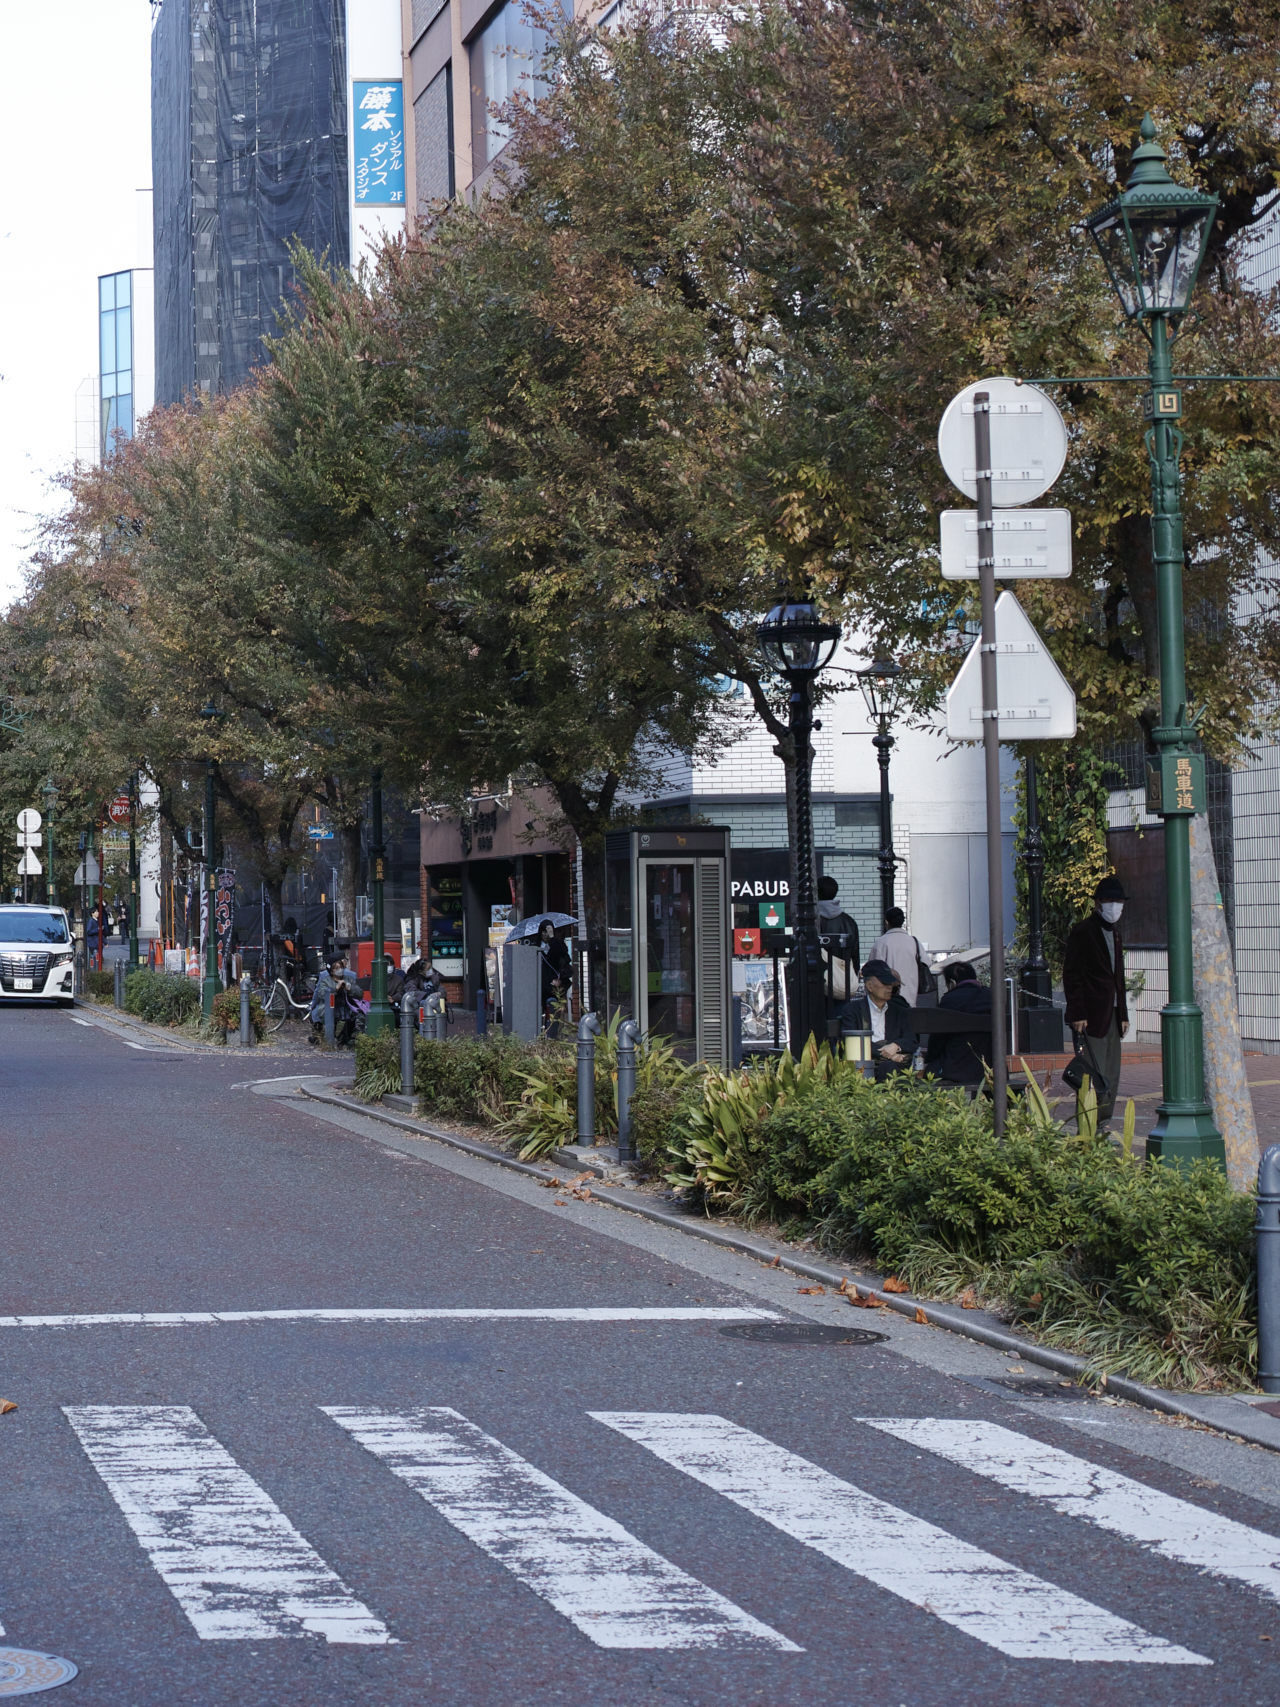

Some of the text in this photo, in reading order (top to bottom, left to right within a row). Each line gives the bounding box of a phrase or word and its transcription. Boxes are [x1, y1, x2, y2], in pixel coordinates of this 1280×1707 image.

[359, 86, 397, 131] 藤本
[370, 142, 388, 185] ダンス
[389, 130, 402, 170] ソシアル
[356, 158, 369, 199] スタジオ
[390, 191, 403, 201] 2F
[1174, 758, 1195, 810] 馬車道
